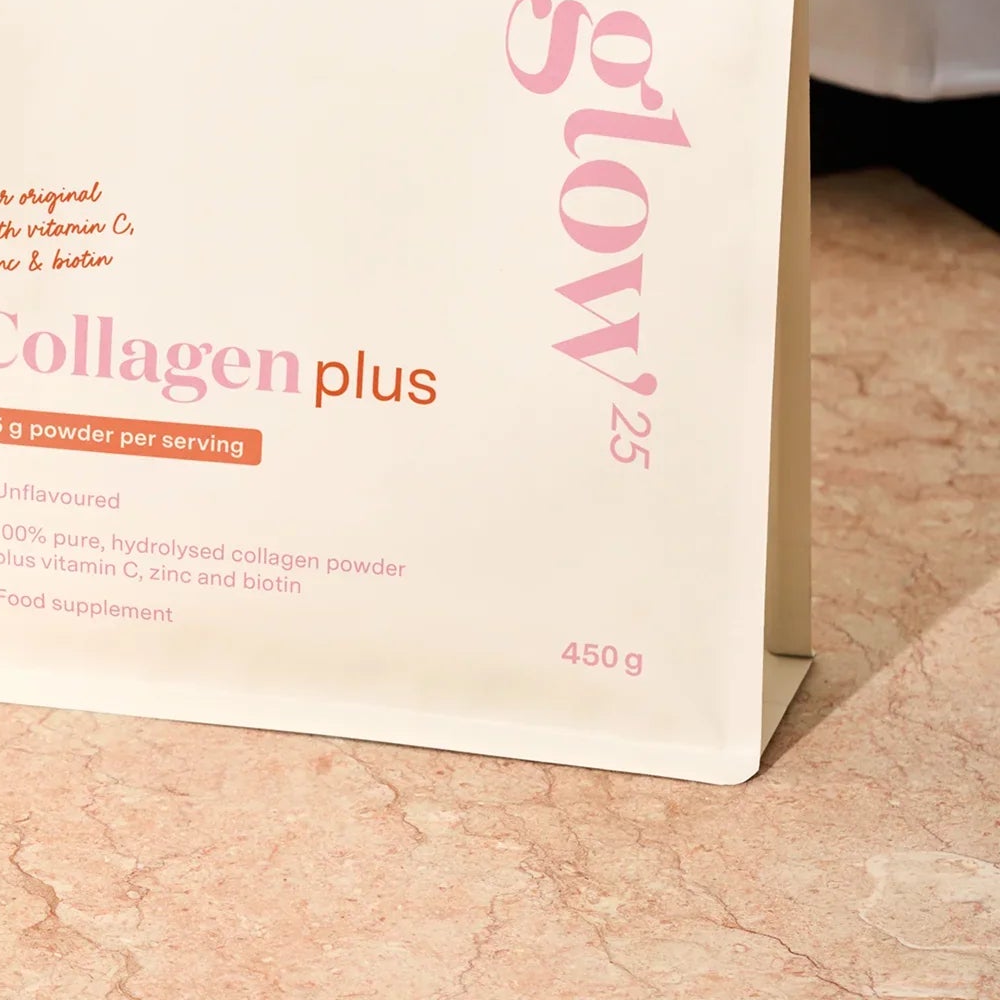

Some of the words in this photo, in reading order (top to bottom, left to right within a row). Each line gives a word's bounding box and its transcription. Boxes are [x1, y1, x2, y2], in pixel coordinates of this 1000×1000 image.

[18, 181, 102, 215] original
[27, 217, 106, 239] vitamin
[112, 212, 134, 235] C,
[27, 250, 43, 272] &
[51, 248, 114, 270] biotin
[315, 350, 438, 408] plus
[9, 422, 23, 440] g
[29, 422, 114, 444] powder
[120, 432, 157, 449] per
[162, 435, 244, 459] serving
[609, 404, 652, 469] 25
[53, 533, 105, 552] pure,
[112, 534, 225, 561] hydrolysed
[232, 547, 319, 571] collagen
[326, 558, 406, 577] powder
[42, 555, 116, 576] vitamin
[123, 561, 143, 582] C,
[150, 565, 192, 584] zinc
[198, 570, 237, 588] and
[243, 572, 301, 593] biotin
[52, 599, 173, 623] supplement
[561, 642, 619, 669] 450
[624, 652, 644, 677] g
